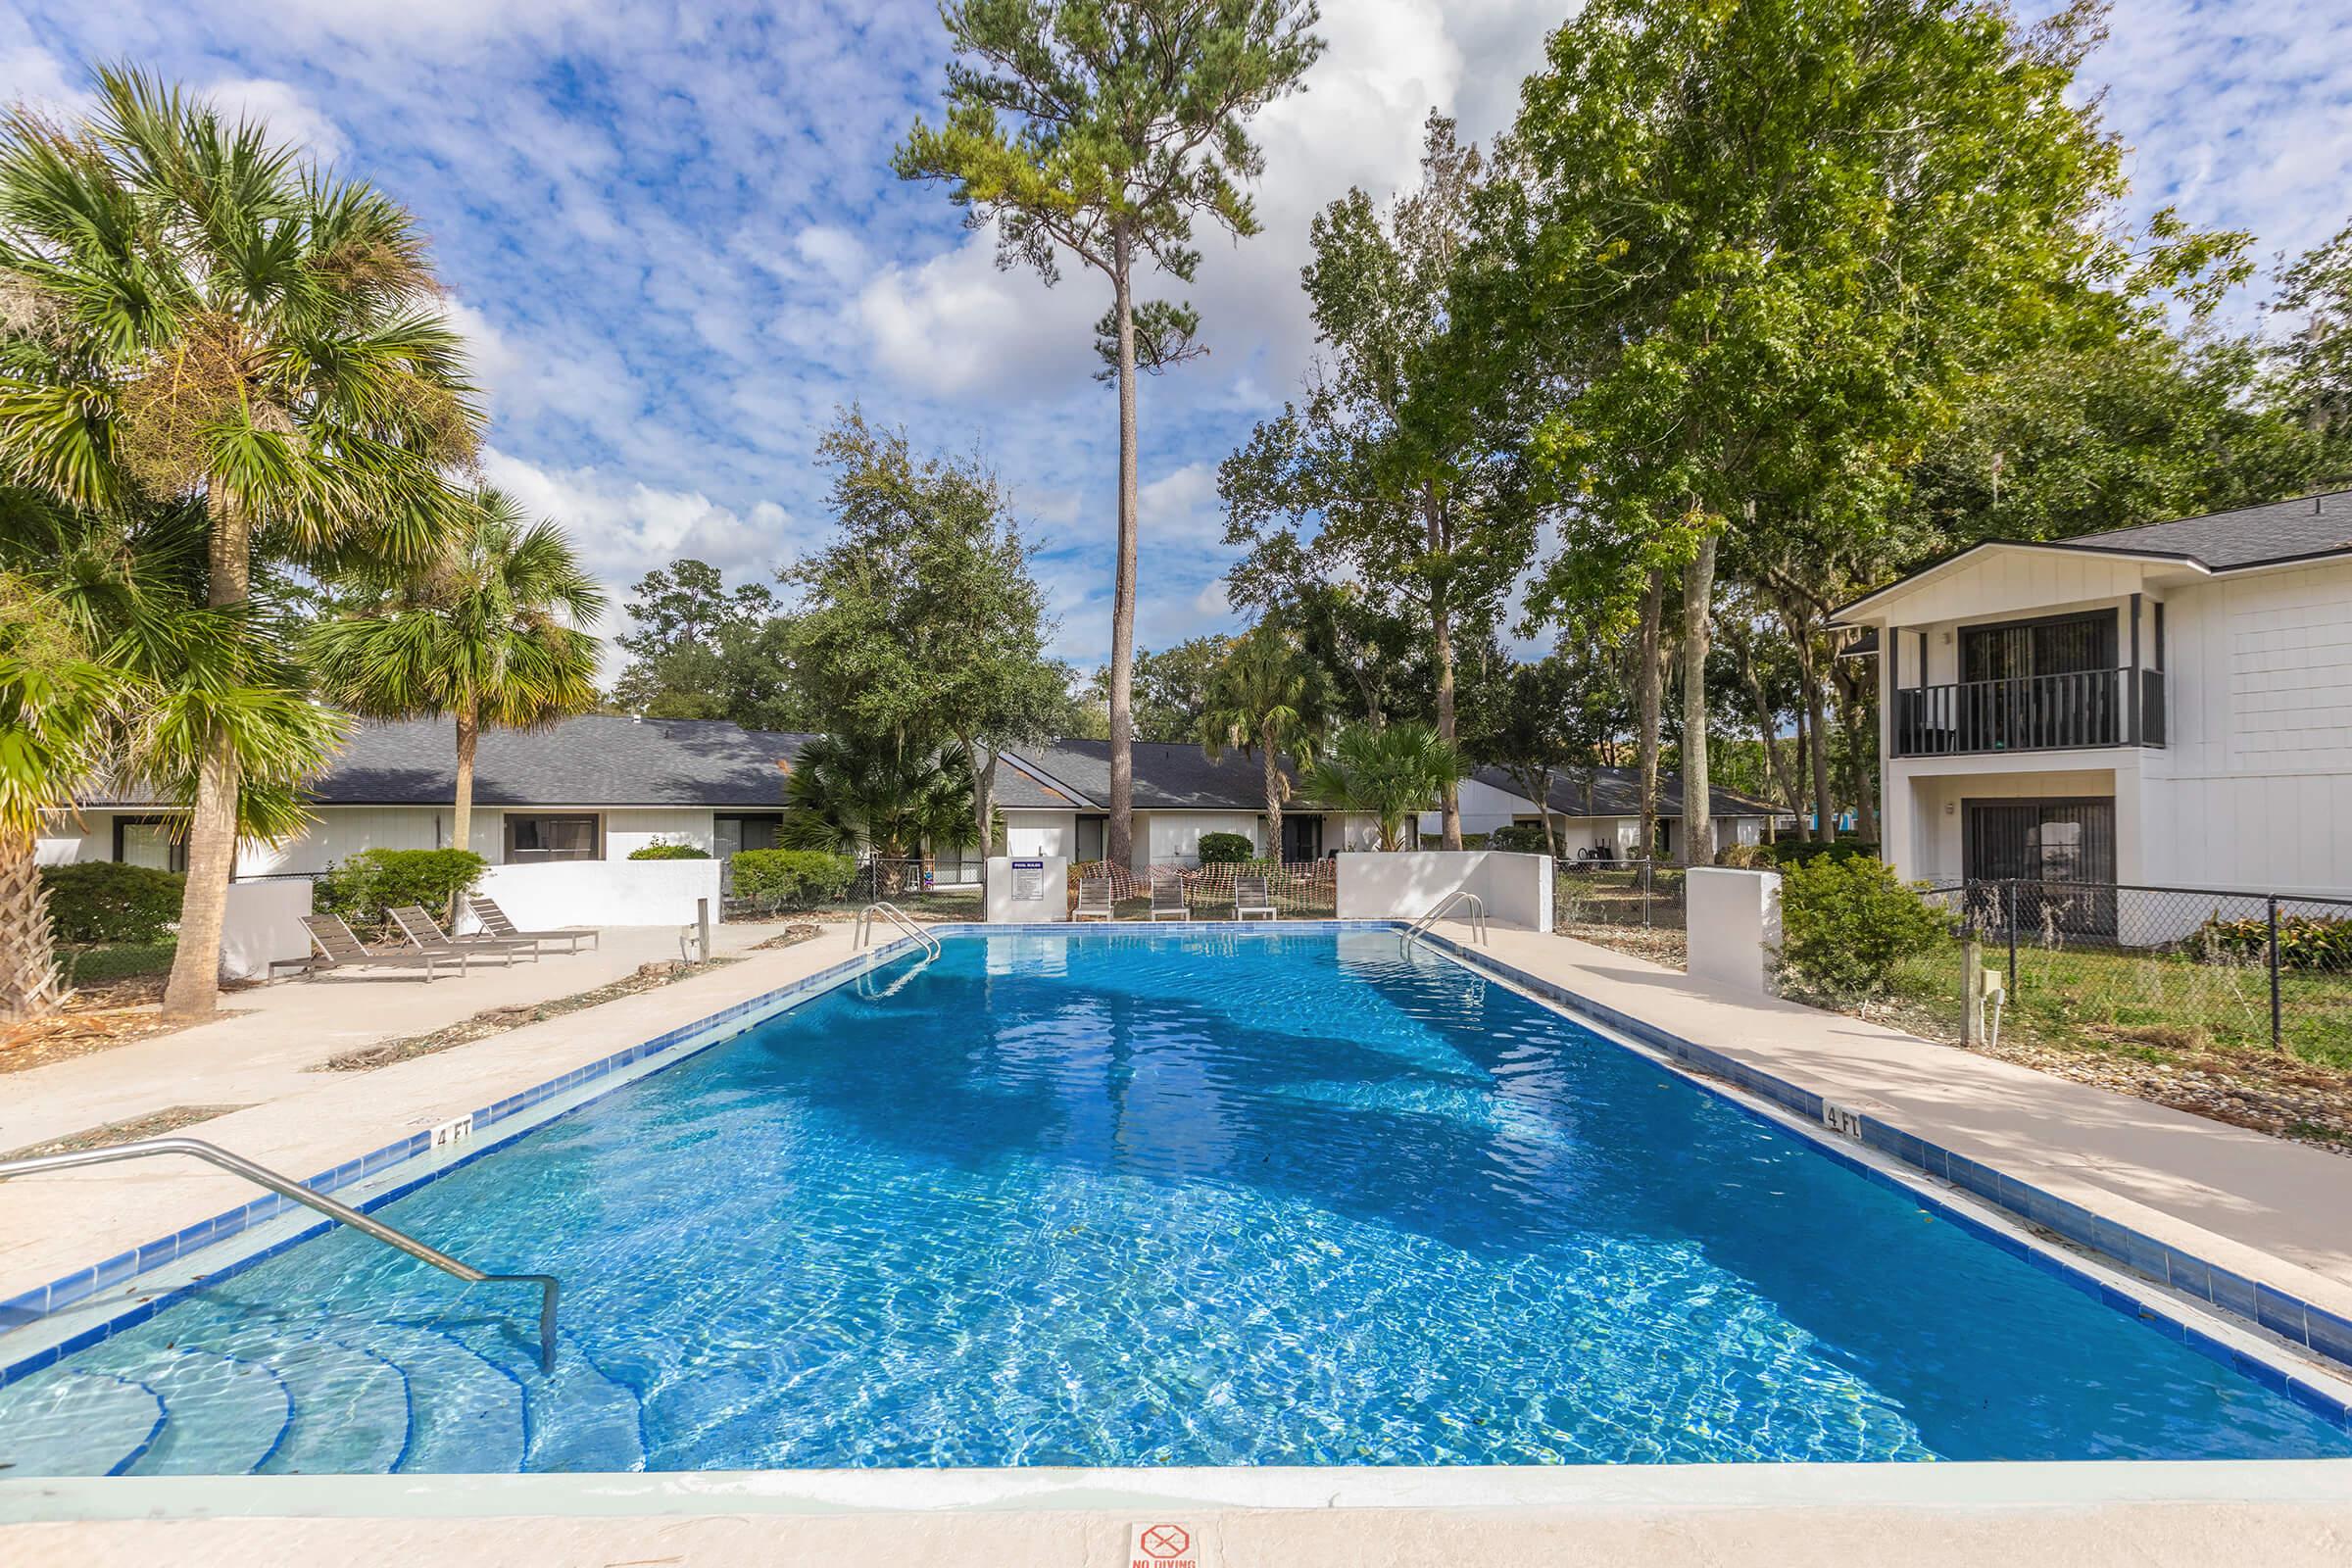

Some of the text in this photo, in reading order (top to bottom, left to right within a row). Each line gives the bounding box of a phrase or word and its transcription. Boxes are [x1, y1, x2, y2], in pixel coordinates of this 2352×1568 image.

[1828, 1106, 1838, 1127] 4
[437, 1118, 471, 1146] 4 FT
[1132, 1559, 1197, 1568] NO DIVING
